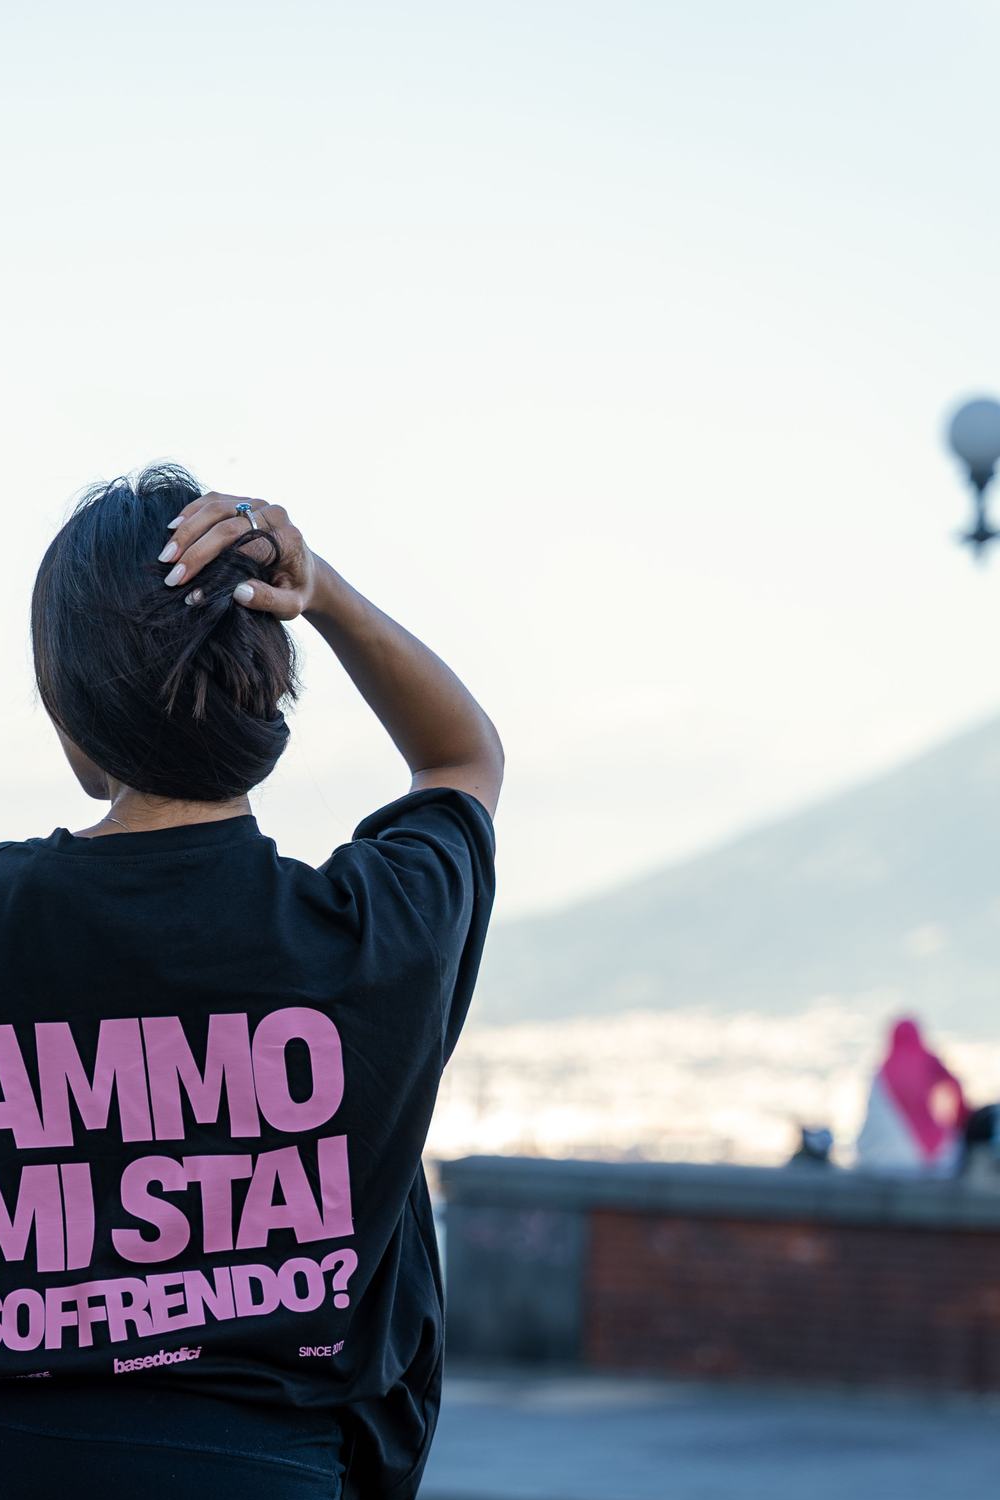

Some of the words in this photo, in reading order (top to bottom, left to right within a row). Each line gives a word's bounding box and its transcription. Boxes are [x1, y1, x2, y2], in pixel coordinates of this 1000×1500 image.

[112, 1134, 354, 1264] STAI
[113, 1346, 202, 1374] basedodici
[299, 1346, 332, 1357] SINCE
